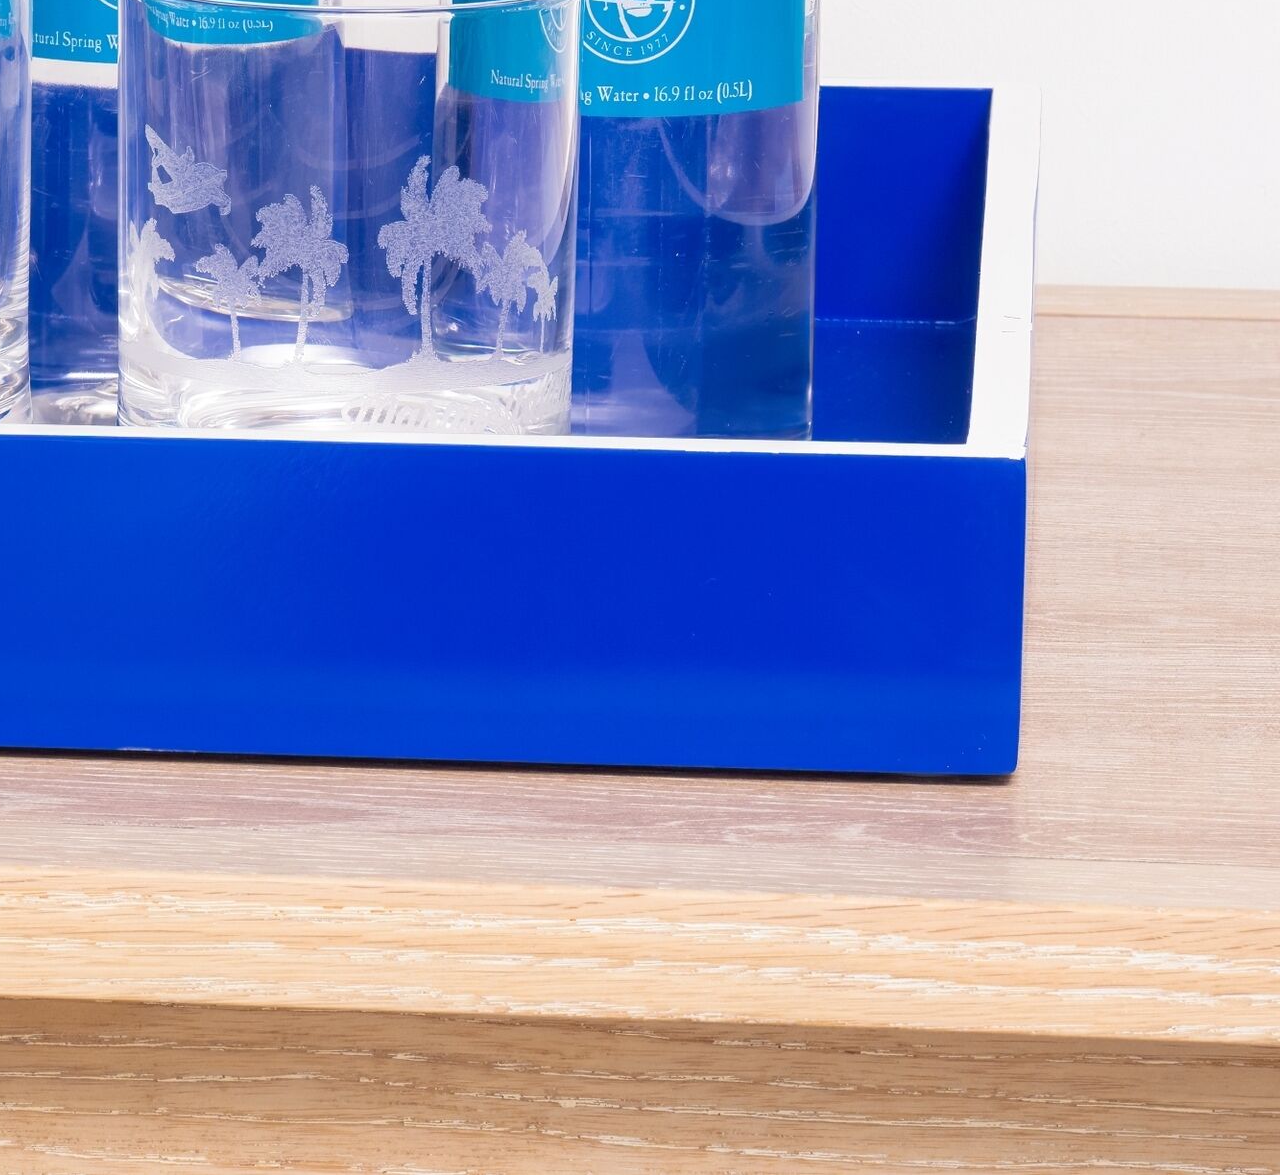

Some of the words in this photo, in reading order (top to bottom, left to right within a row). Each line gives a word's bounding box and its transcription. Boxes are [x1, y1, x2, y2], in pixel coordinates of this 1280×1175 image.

[198, 16, 215, 29] 16.9
[228, 21, 240, 29] oz
[62, 31, 102, 54] Spring
[586, 30, 633, 57] SINCE
[640, 33, 669, 56] 1977
[490, 69, 523, 88] Natural
[597, 85, 640, 103] Water
[654, 85, 680, 103] 16.9
[698, 89, 714, 101] oz
[716, 79, 754, 105] (0.5L)
